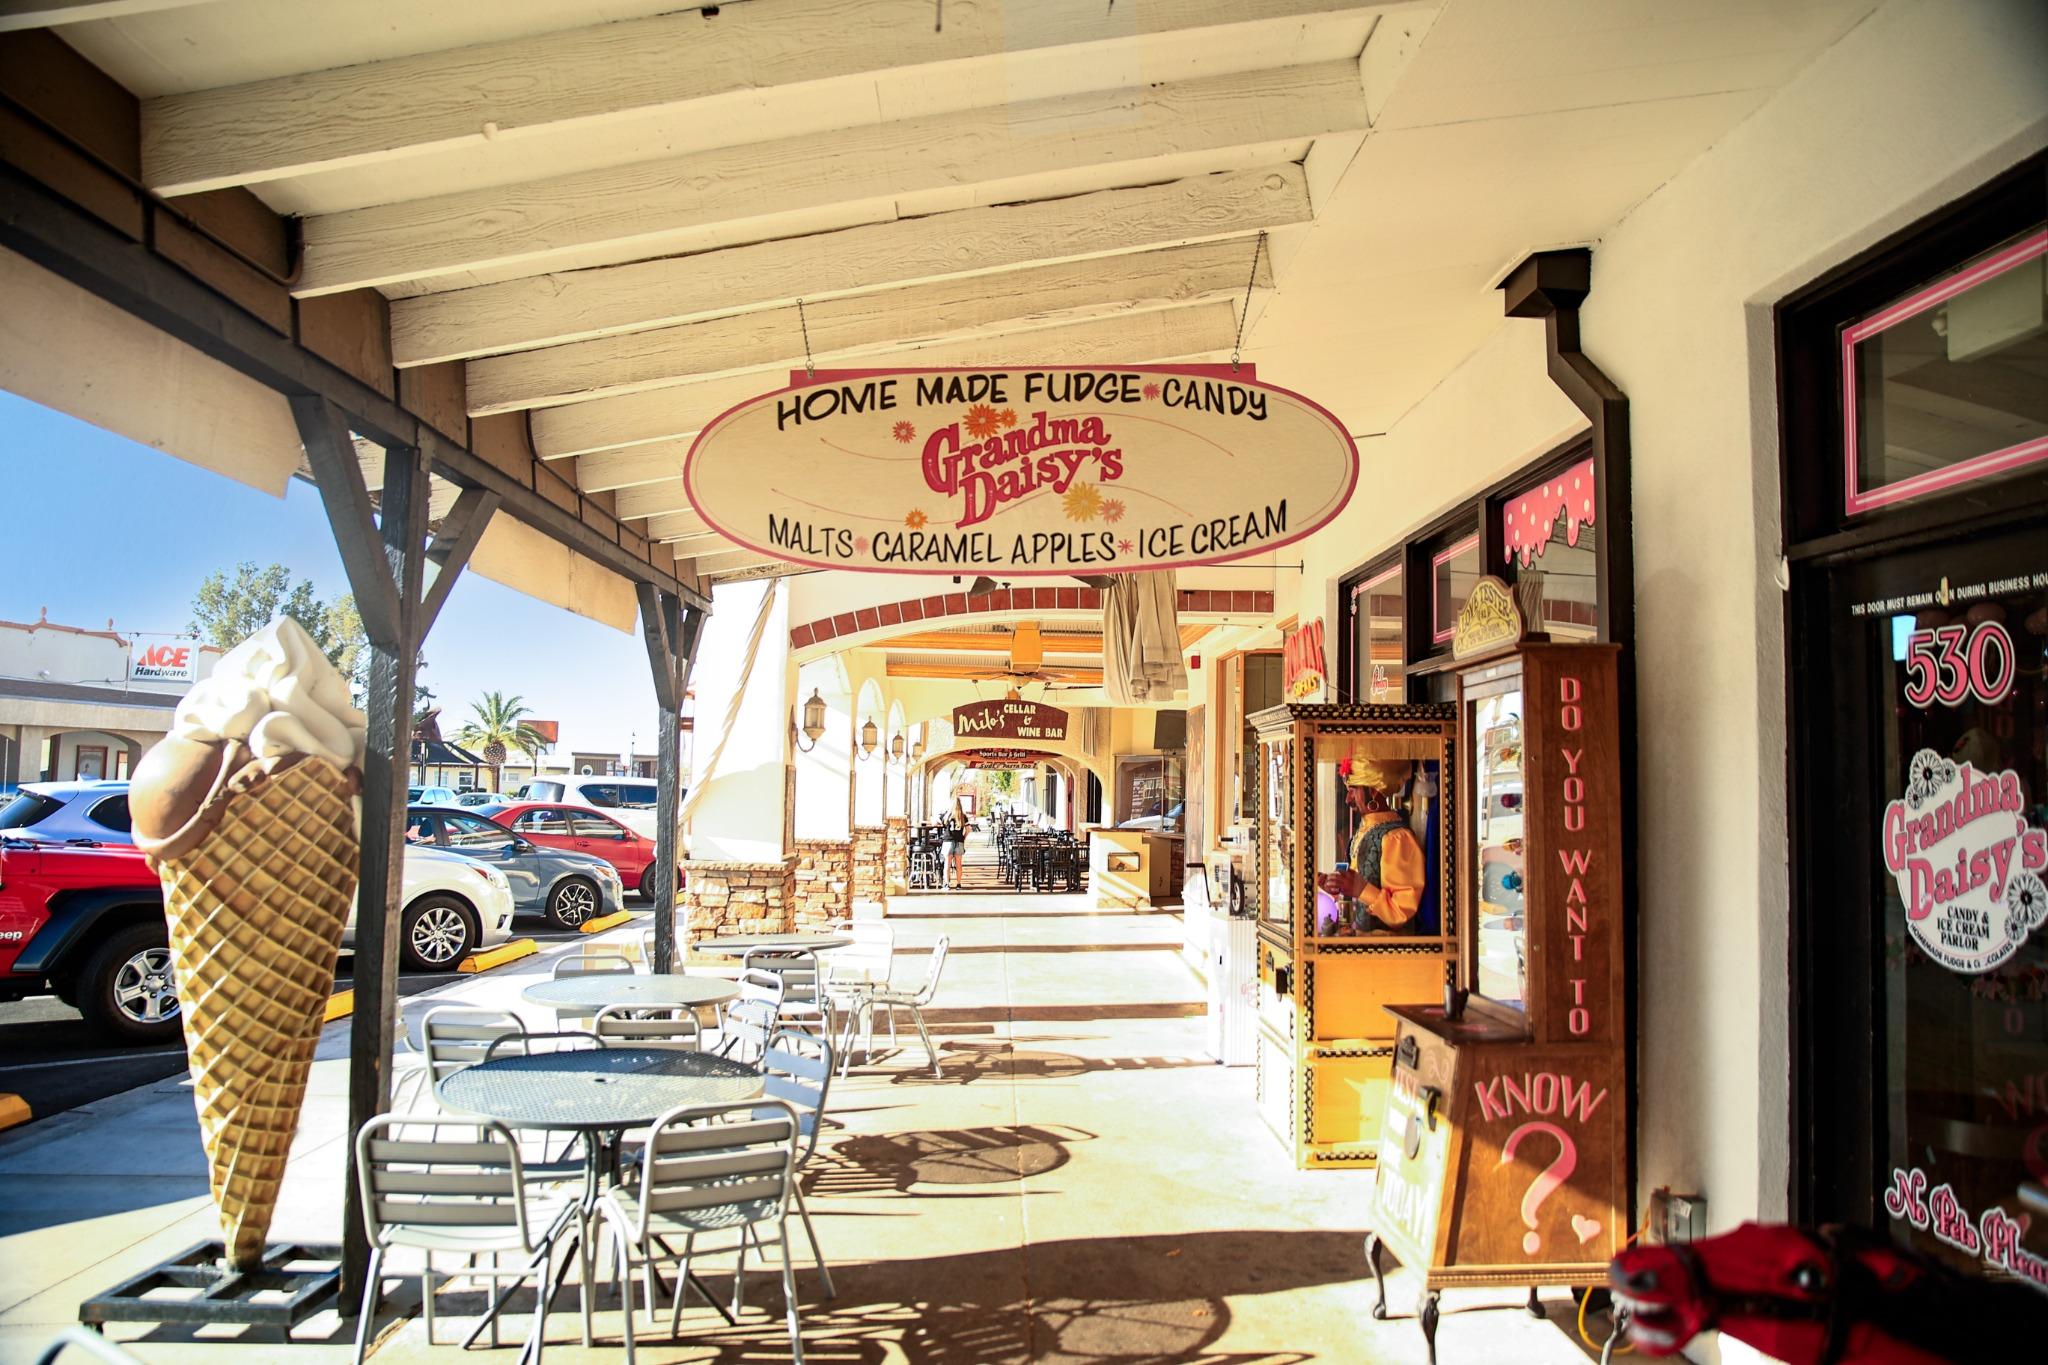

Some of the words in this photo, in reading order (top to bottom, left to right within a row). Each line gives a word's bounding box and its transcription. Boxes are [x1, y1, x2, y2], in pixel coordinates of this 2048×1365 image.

[777, 380, 898, 431] HOME
[916, 373, 1009, 407] MADE
[1024, 372, 1142, 403] FUDGE
[1162, 378, 1268, 421] CANDY
[921, 411, 1112, 498] Grandma
[955, 447, 1124, 529] Daisy's
[769, 513, 853, 558] MALTS
[872, 532, 1002, 563] CARAMEL
[1011, 531, 1117, 565] APPLES
[1139, 525, 1185, 559] ICE
[1191, 499, 1287, 555] CREAM
[1480, 584, 1510, 617] TESTER
[1851, 604, 1865, 616] THIS
[1867, 600, 1885, 614] DOOR
[1887, 596, 1905, 612] MUST
[1906, 592, 1933, 607] REMAIN
[1935, 588, 1955, 602] ON
[1957, 583, 1986, 600] DURING
[1988, 575, 2030, 595] BUSINESS
[135, 667, 188, 677] Hardware
[136, 643, 191, 668] ACE
[1905, 621, 2015, 707] 530
[957, 708, 1005, 735] Milo's
[1003, 703, 1037, 715] CELLAR
[1560, 677, 1583, 731] DO
[1017, 726, 1041, 737] WINE
[1045, 727, 1063, 738] BAR
[1561, 748, 1585, 832] YOU
[1884, 764, 2021, 873] Grandma
[1907, 817, 2048, 921] Daisy's
[1559, 849, 1593, 961] WANT
[1937, 917, 1953, 931] ICE
[1955, 921, 1990, 939] CREAM
[1947, 905, 1980, 922] CANDY
[1981, 911, 1989, 924] &
[1941, 931, 1979, 951] PARLOR
[1569, 979, 1590, 1035] TO
[1474, 1072, 1607, 1123] KNOW
[1885, 1168, 1929, 1230] No
[1930, 1184, 1980, 1256] Pets
[1981, 1207, 2048, 1292] Plea
